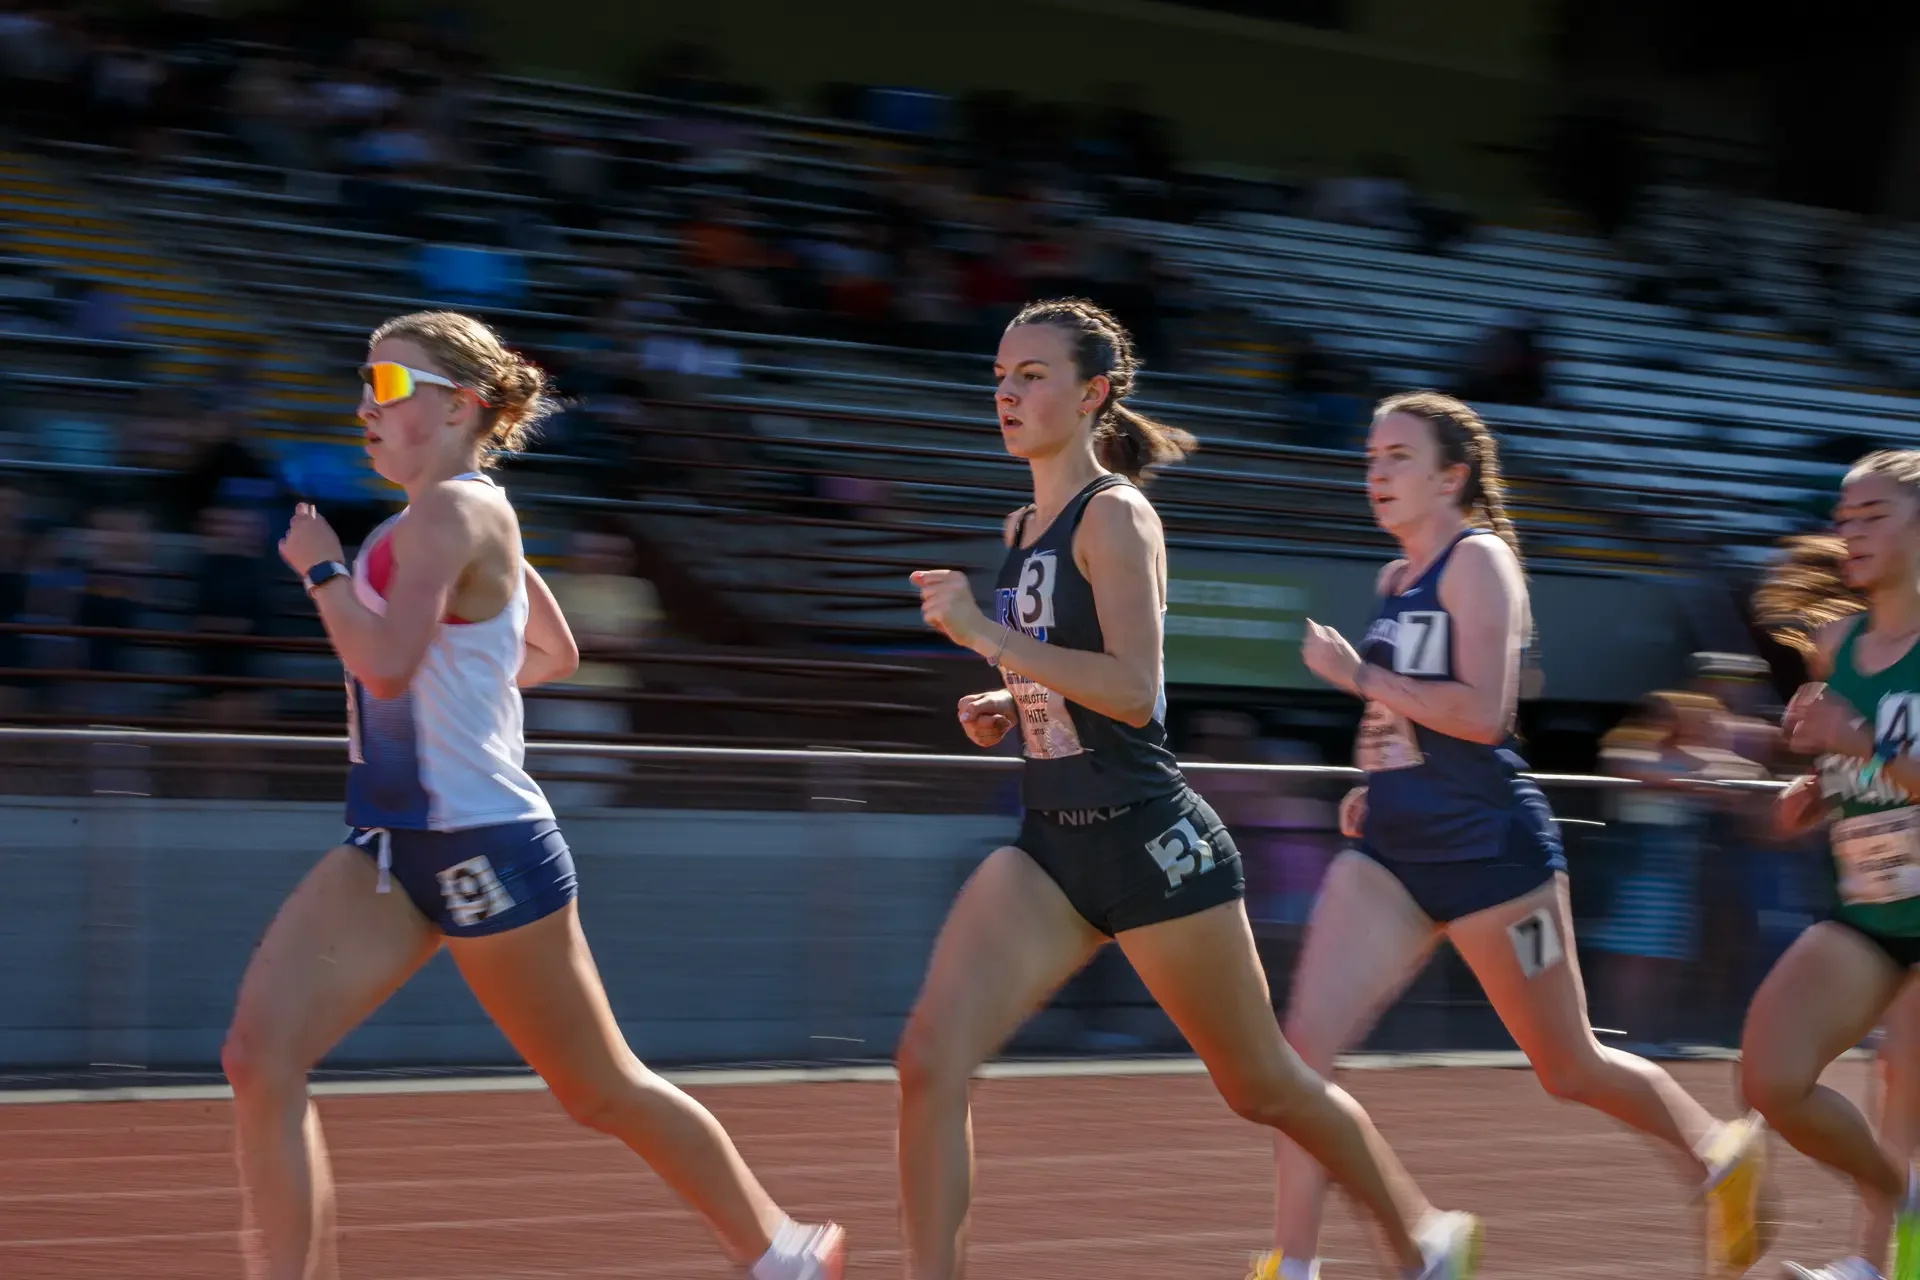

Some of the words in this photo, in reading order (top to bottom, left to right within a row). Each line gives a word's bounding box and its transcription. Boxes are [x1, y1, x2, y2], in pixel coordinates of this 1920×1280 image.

[1023, 559, 1045, 624] 3
[1406, 613, 1436, 670] 7
[1879, 698, 1918, 758] 4
[1159, 828, 1203, 880] 3
[452, 867, 490, 921] 9
[1513, 914, 1546, 969] 7
